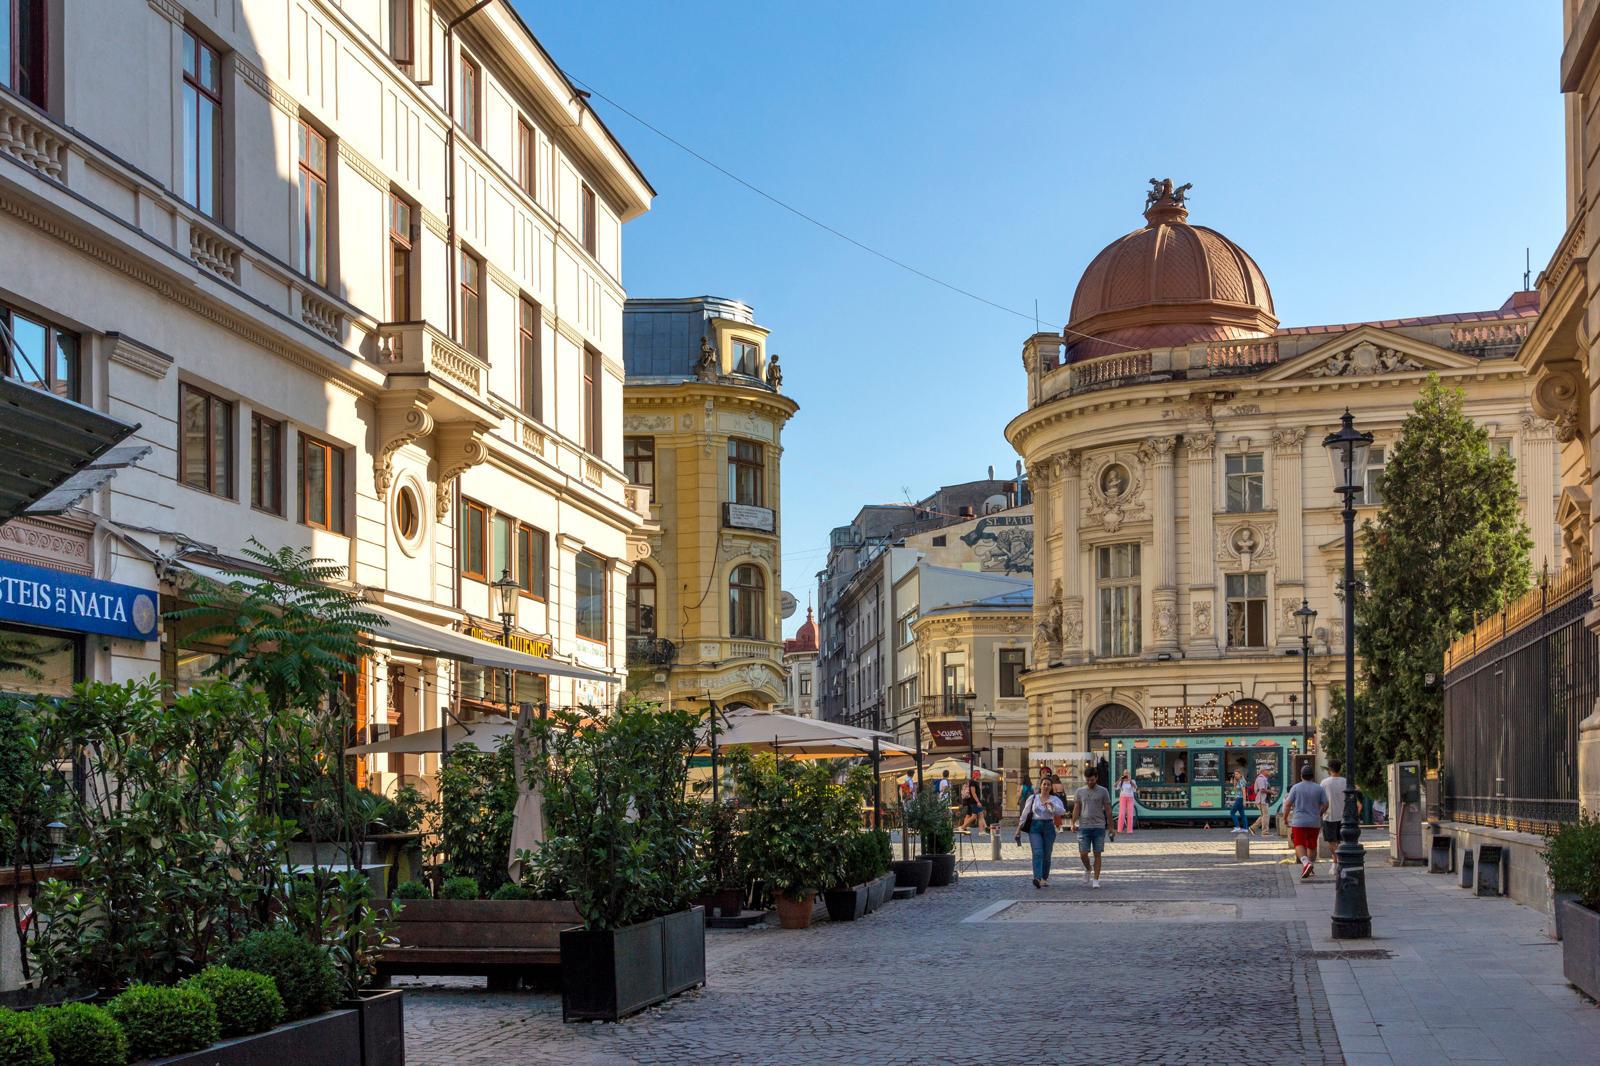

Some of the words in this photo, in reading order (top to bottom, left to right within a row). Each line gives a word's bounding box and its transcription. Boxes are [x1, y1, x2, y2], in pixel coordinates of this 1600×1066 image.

[0, 577, 51, 610] TEIS
[56, 587, 67, 614] DE
[70, 589, 127, 623] NATA
